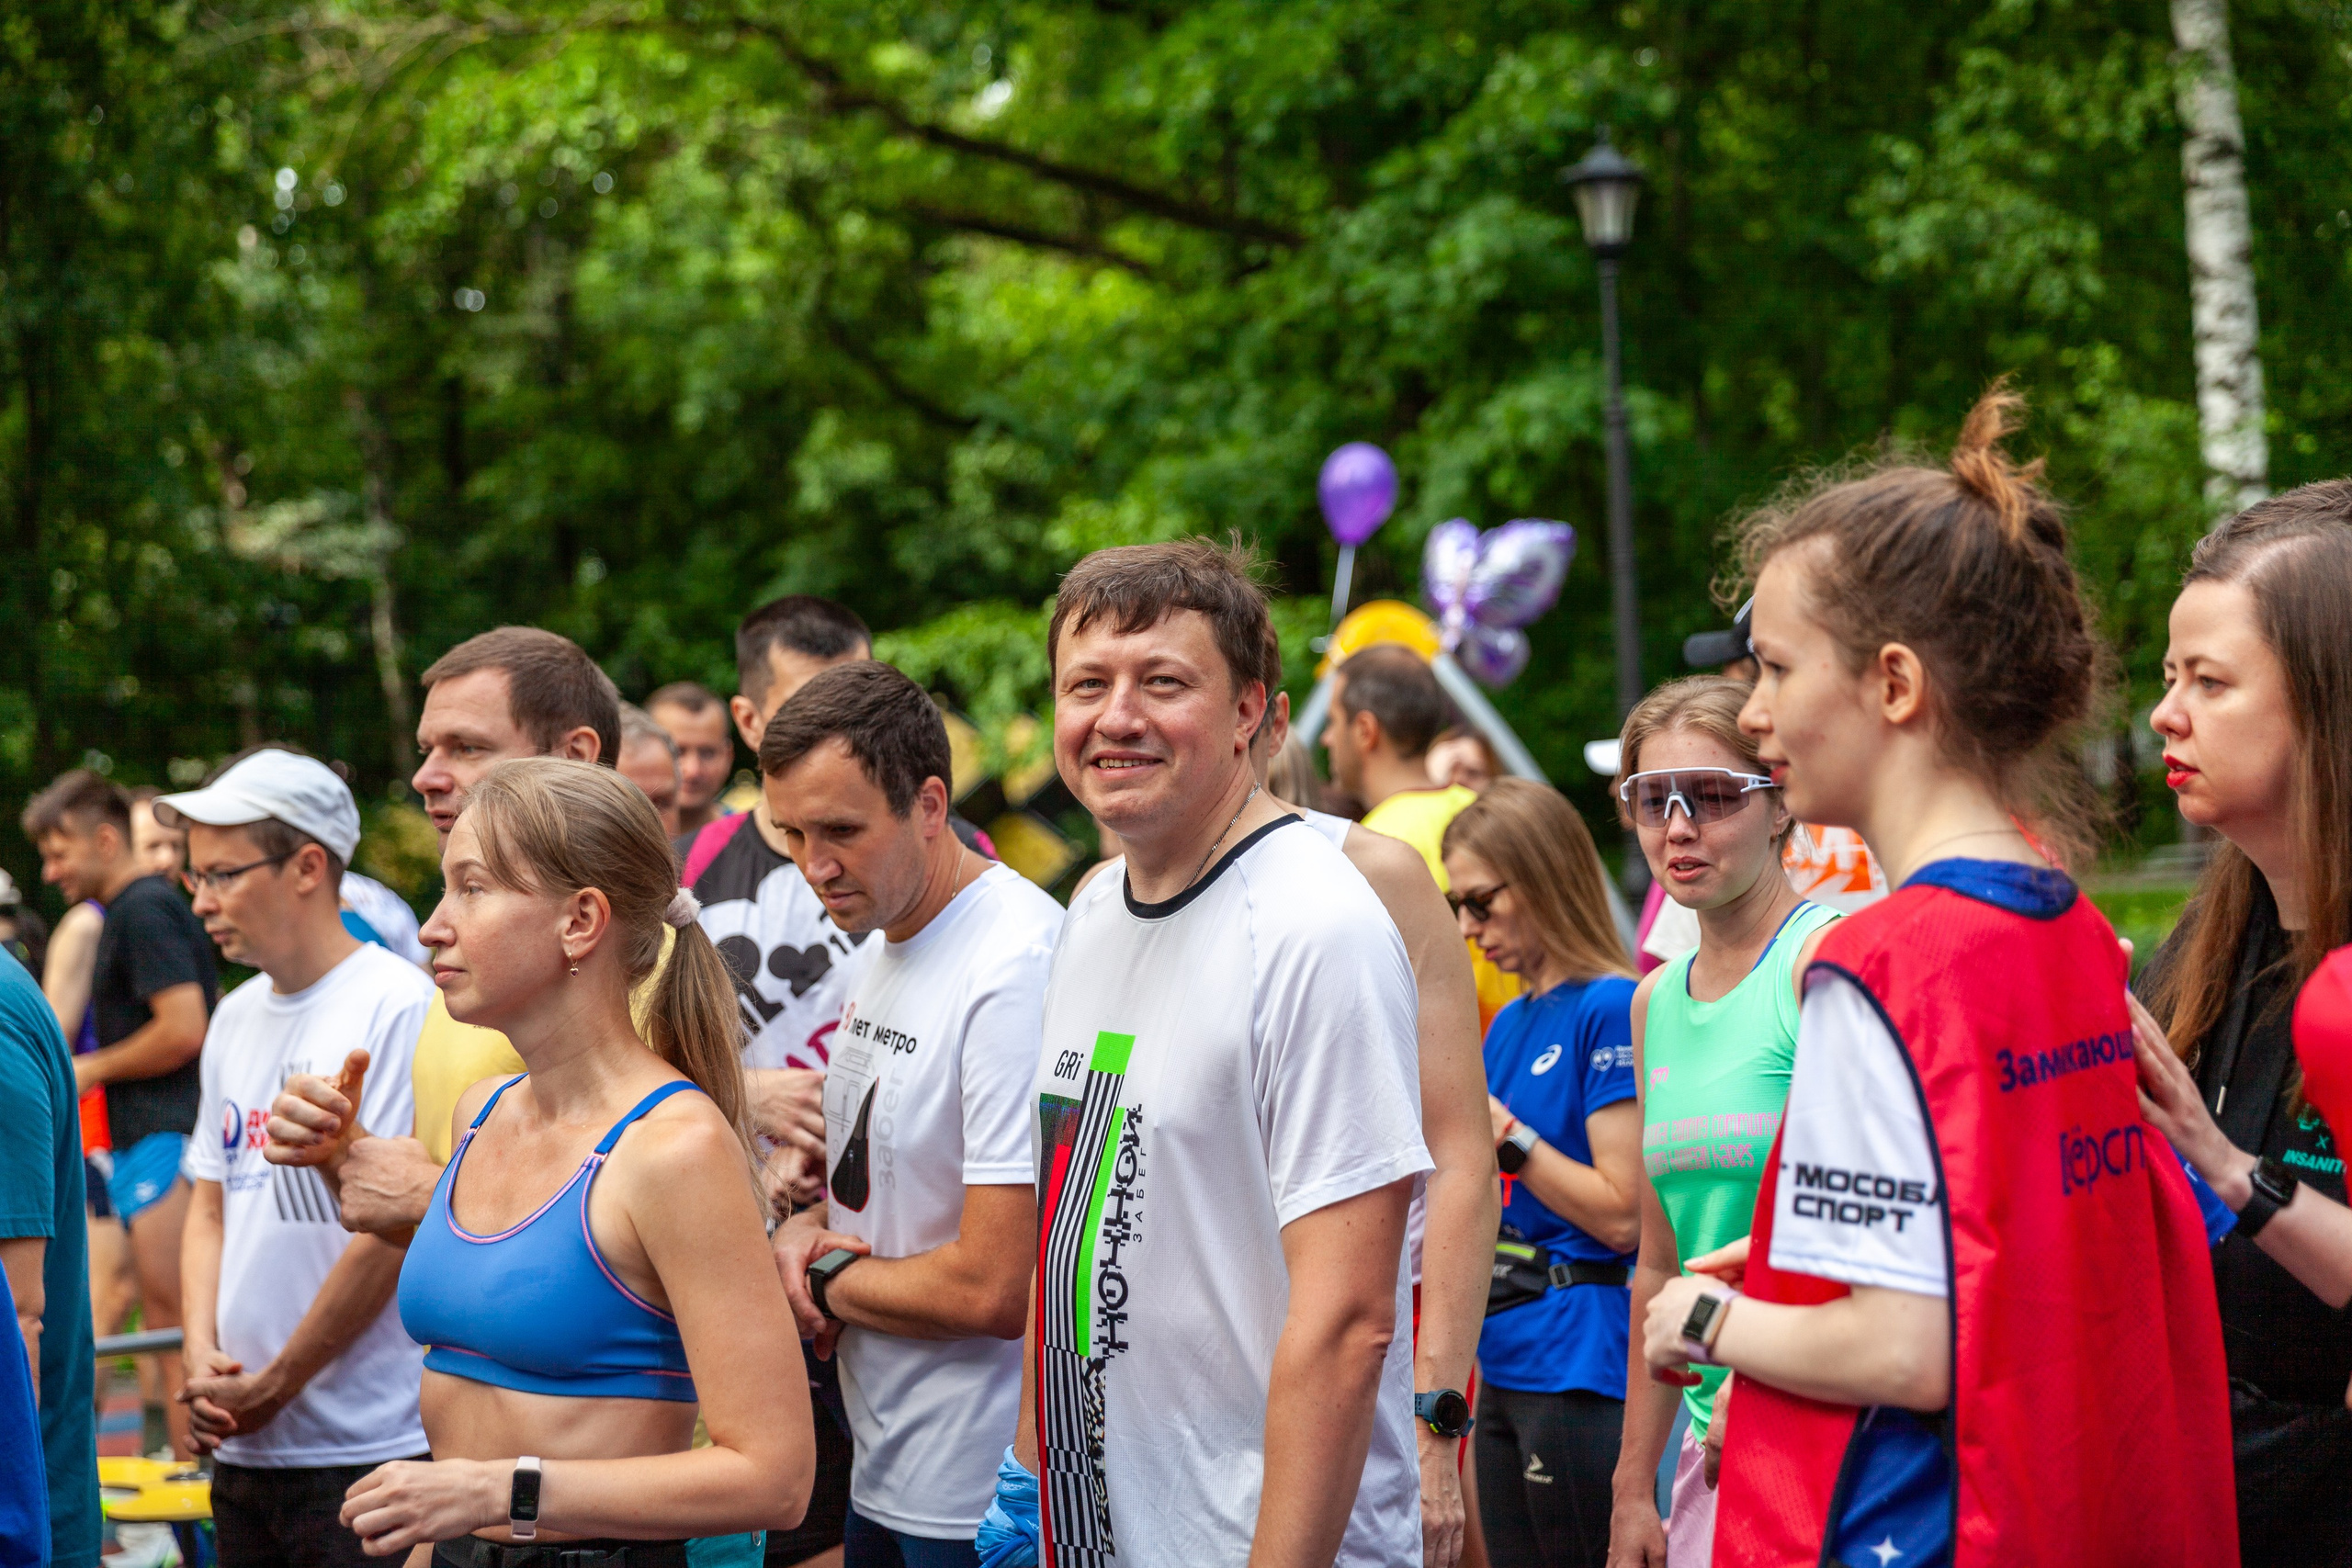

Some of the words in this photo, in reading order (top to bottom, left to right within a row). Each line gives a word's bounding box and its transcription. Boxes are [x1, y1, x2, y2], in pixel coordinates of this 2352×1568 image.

[873, 1025, 917, 1055] метро
[873, 1067, 903, 1190] забег
[1712, 1111, 1785, 1138] communit
[1133, 1147, 1148, 1243] ЗАБЕГ
[1795, 1162, 1938, 1206] МОСОБ
[1792, 1192, 1914, 1233] СПОРТ
